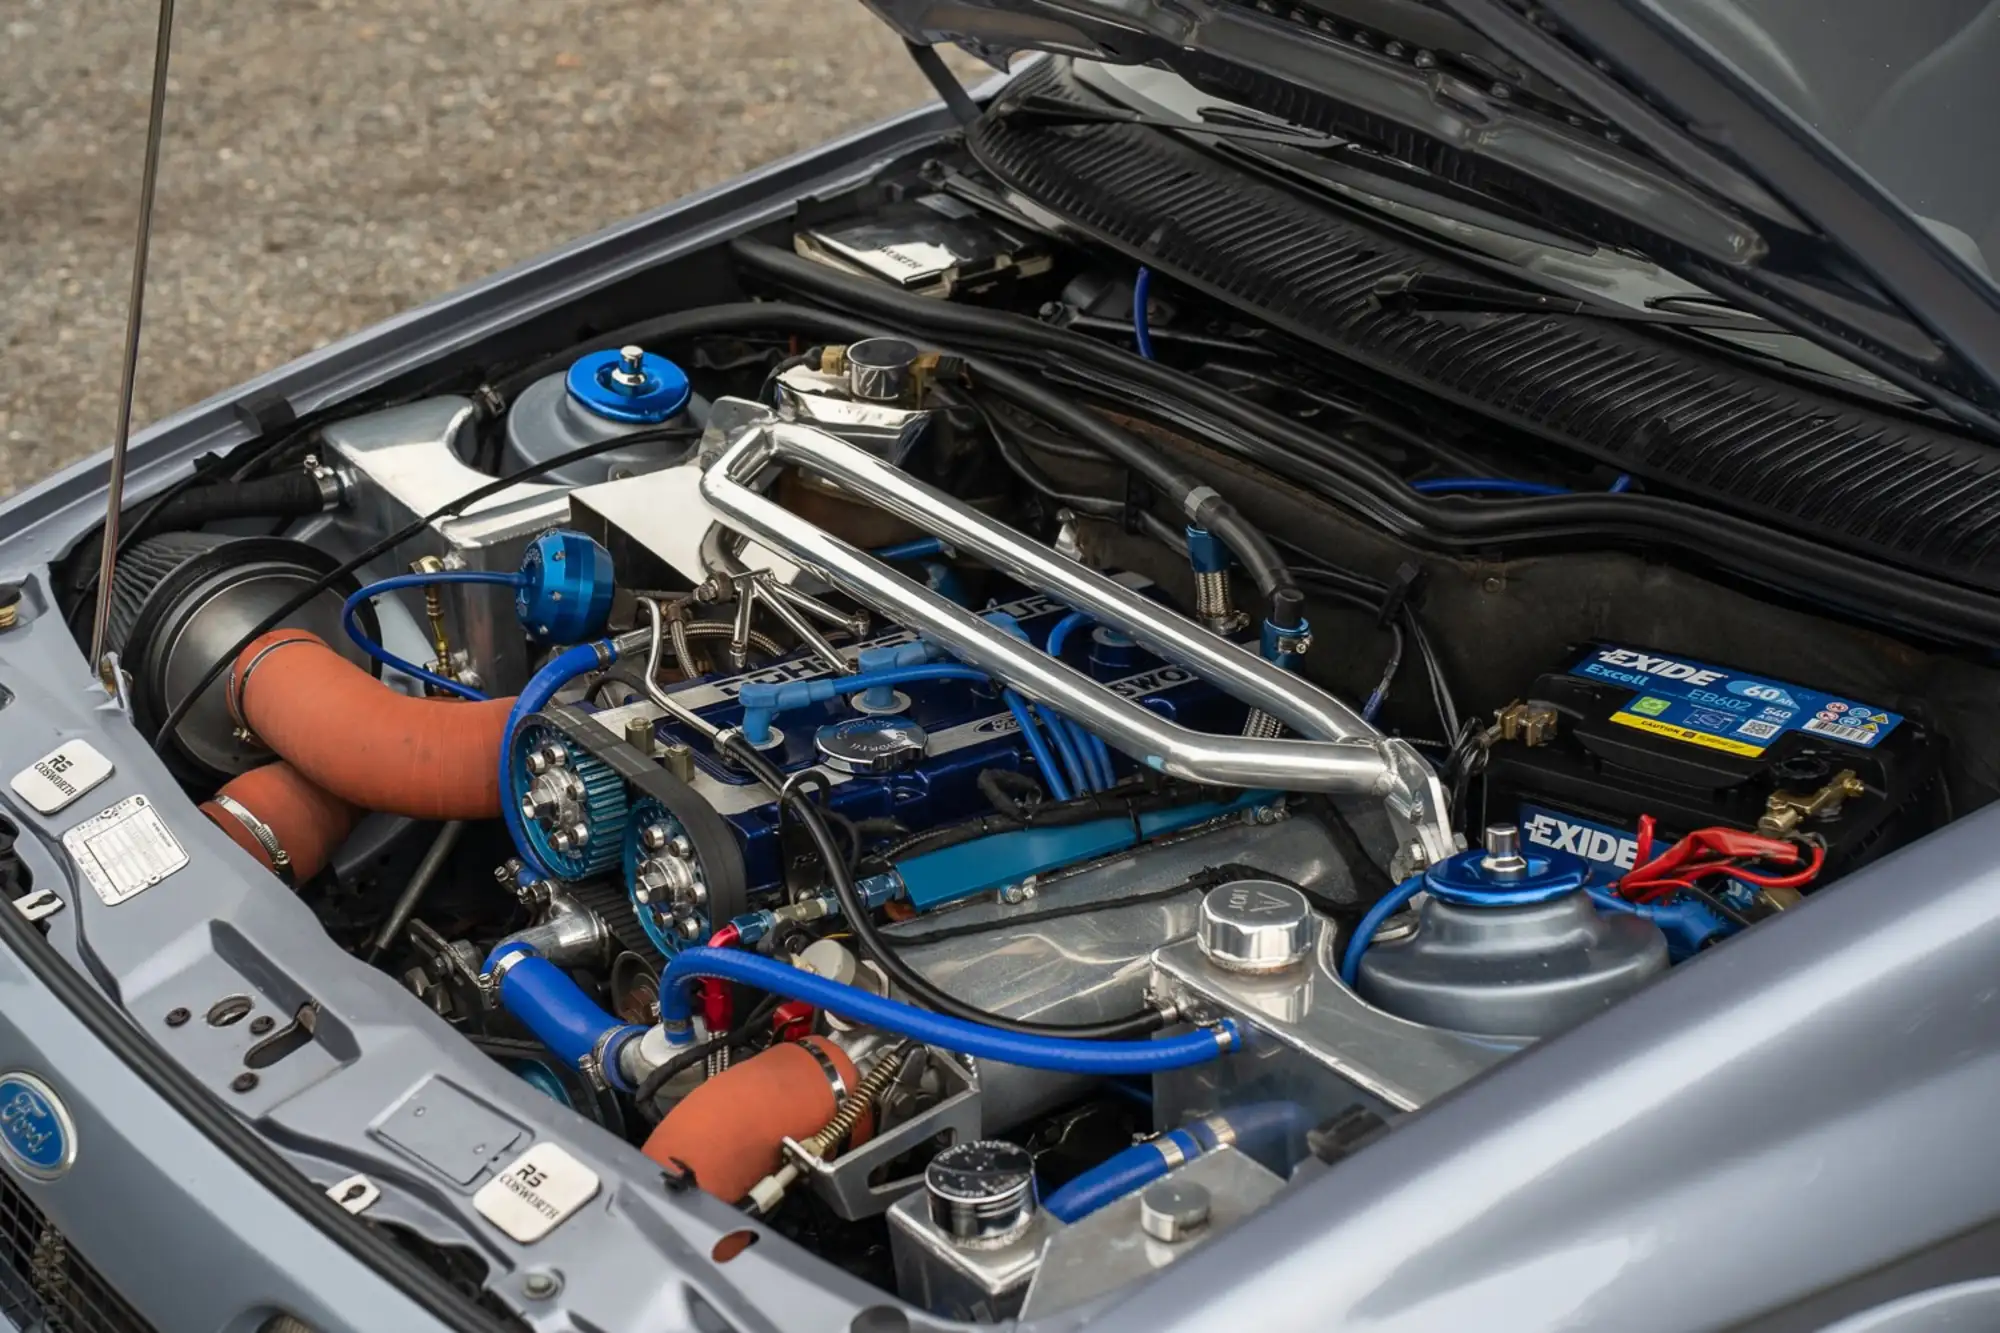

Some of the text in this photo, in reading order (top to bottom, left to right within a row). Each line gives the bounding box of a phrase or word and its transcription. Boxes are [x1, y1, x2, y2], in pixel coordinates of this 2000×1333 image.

[1584, 663, 1650, 686] Excell
[1599, 649, 1725, 686] EXIDE
[1687, 688, 1753, 712] EB602
[1743, 685, 1781, 701] 60
[48, 754, 74, 773] RS
[33, 761, 77, 797] COSWORTH
[1524, 813, 1640, 870] EXIDE
[2, 1091, 53, 1153] Ford
[515, 1163, 548, 1188] RS
[499, 1173, 560, 1220] COSWORTH
